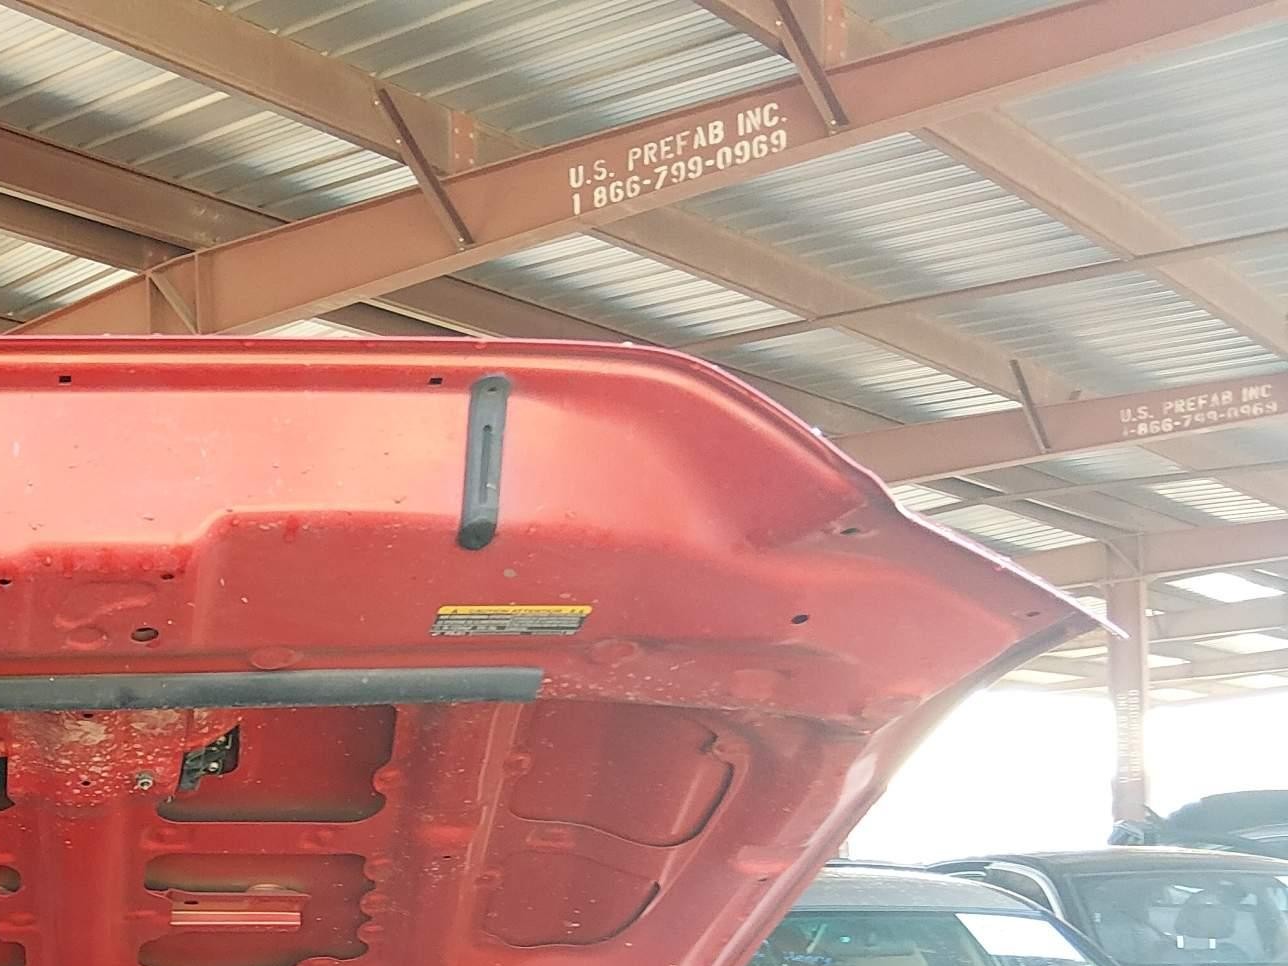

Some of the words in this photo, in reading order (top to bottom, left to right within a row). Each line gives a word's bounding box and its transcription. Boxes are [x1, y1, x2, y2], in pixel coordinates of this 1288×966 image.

[569, 159, 615, 188] U.S.
[628, 120, 725, 171] PREFAB
[737, 102, 788, 137] INC.
[571, 192, 581, 215] 1
[593, 129, 788, 208] 866-799-0969
[1163, 390, 1233, 415] PREFAB
